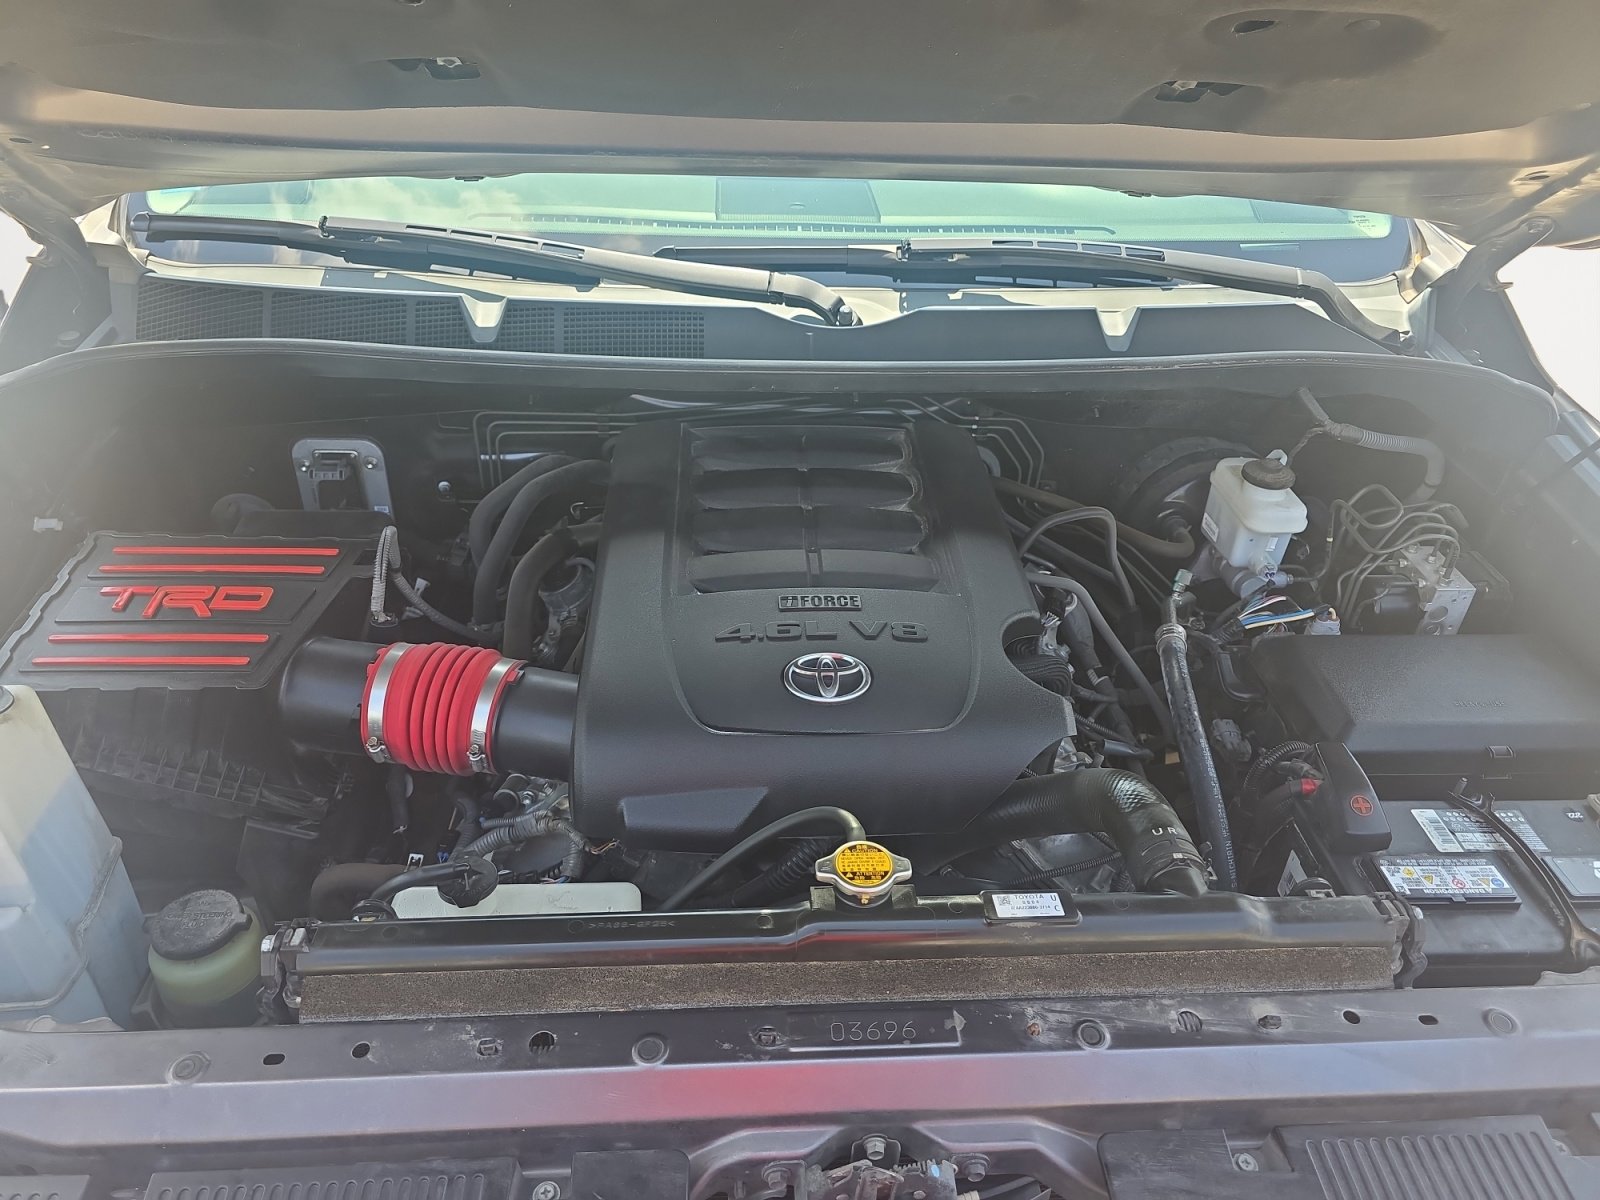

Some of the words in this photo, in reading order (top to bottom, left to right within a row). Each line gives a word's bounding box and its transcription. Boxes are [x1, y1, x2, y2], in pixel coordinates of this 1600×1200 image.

[100, 585, 274, 618] TRD
[715, 621, 838, 642] 4.6L
[849, 621, 928, 642] V8
[1050, 894, 1057, 902] U
[1054, 904, 1061, 912] C
[830, 1020, 917, 1042] 03696
